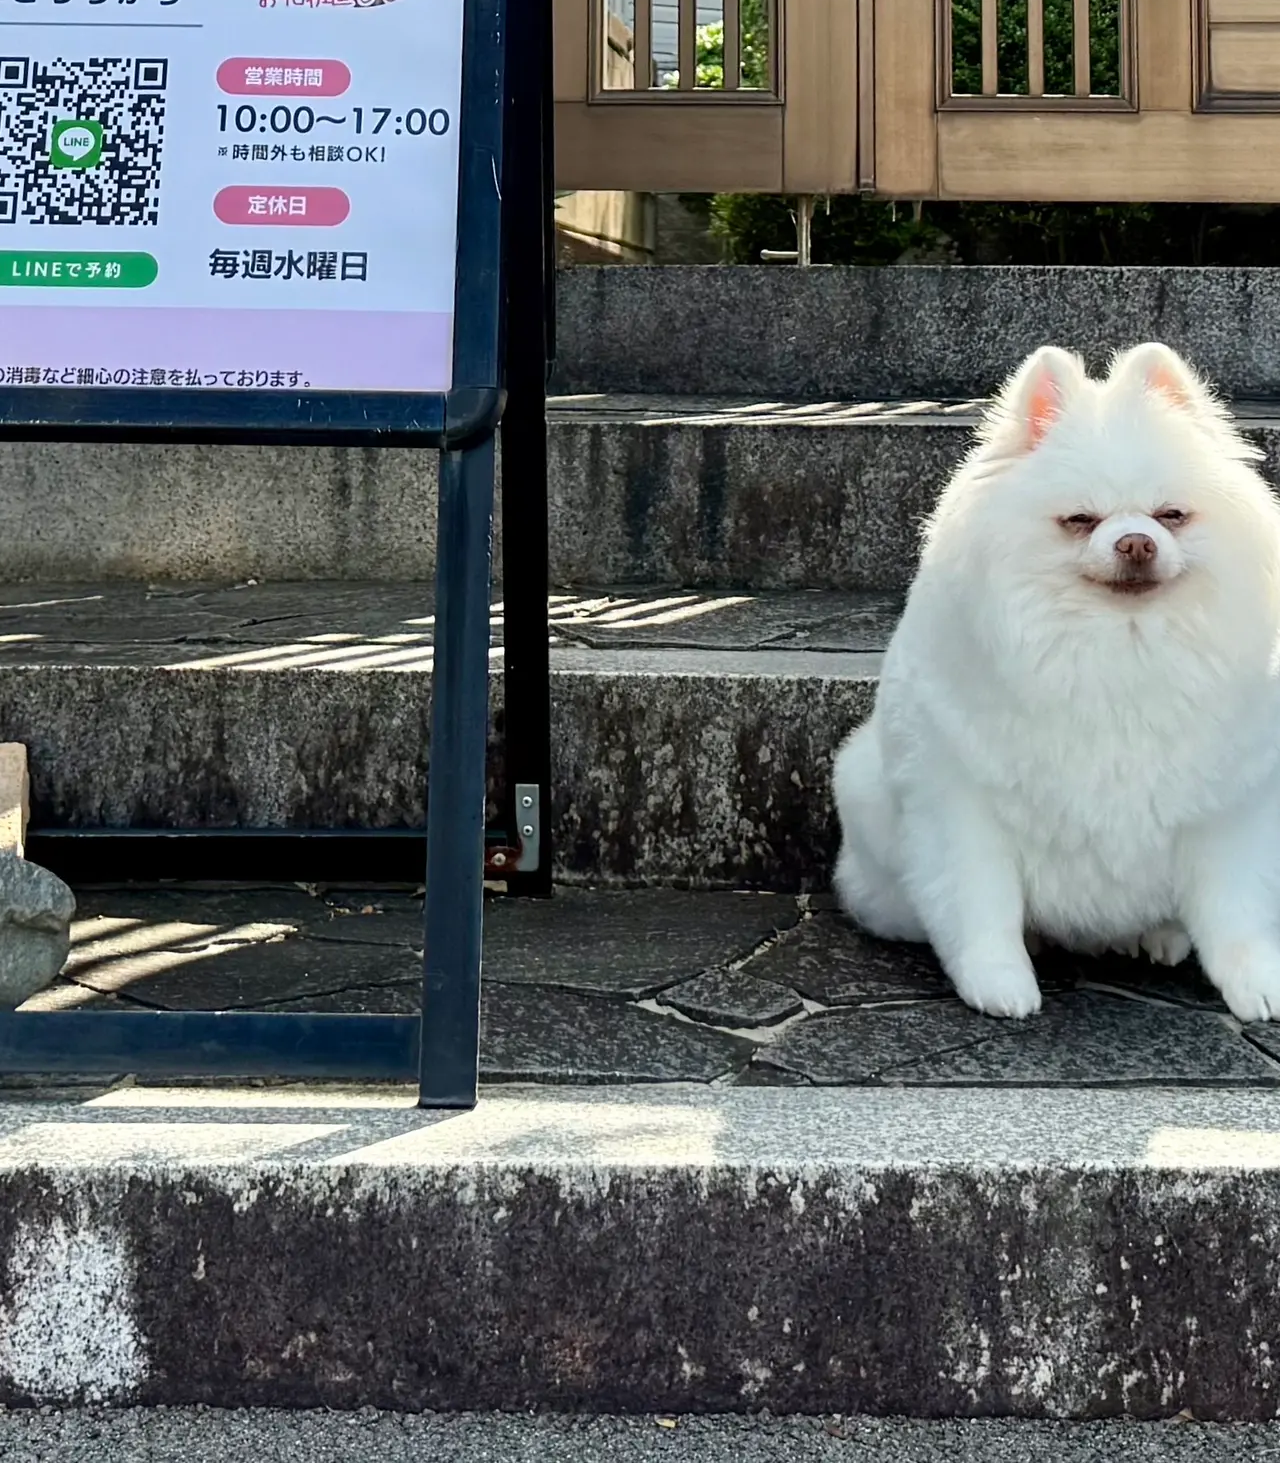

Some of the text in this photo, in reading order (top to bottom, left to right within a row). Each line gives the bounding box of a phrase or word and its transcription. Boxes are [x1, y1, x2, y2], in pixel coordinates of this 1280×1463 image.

[244, 66, 323, 88] 営業時間
[63, 137, 90, 147] LINE
[247, 195, 307, 217] 定休日
[11, 260, 122, 280] LINEで予約
[209, 248, 368, 282] 毎週水曜日
